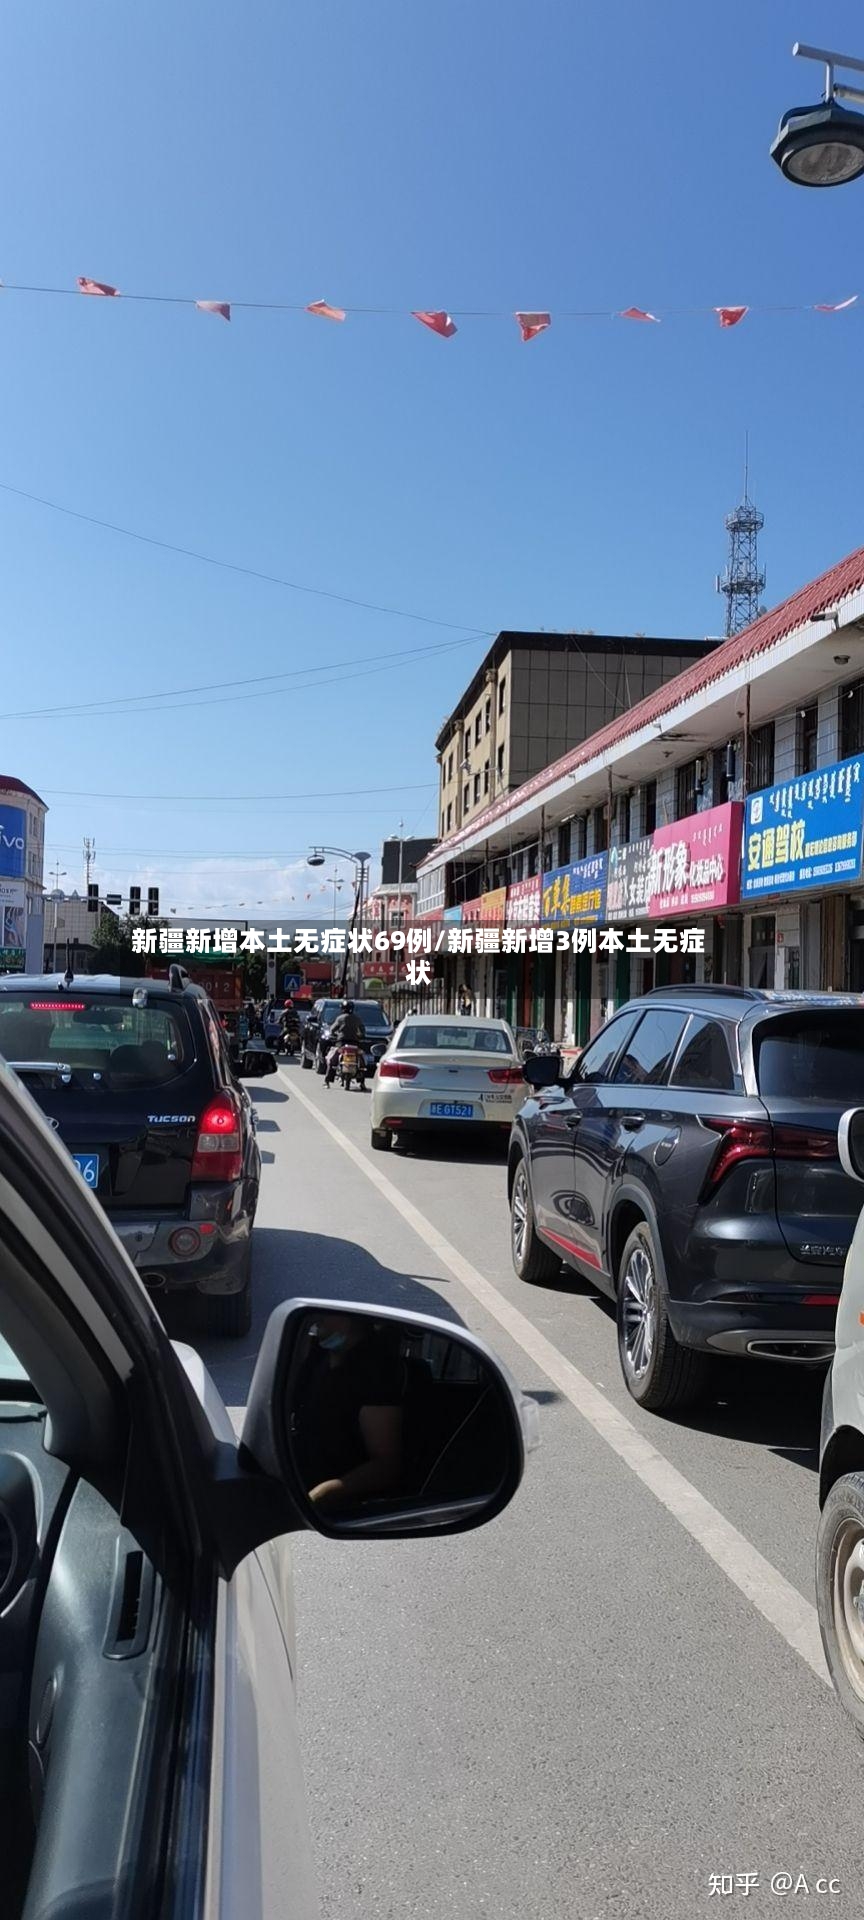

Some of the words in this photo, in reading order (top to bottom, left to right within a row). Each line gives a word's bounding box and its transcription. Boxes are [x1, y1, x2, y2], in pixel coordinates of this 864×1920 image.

[649, 841, 688, 896] 新形象
[690, 853, 724, 887] 化妆品中心
